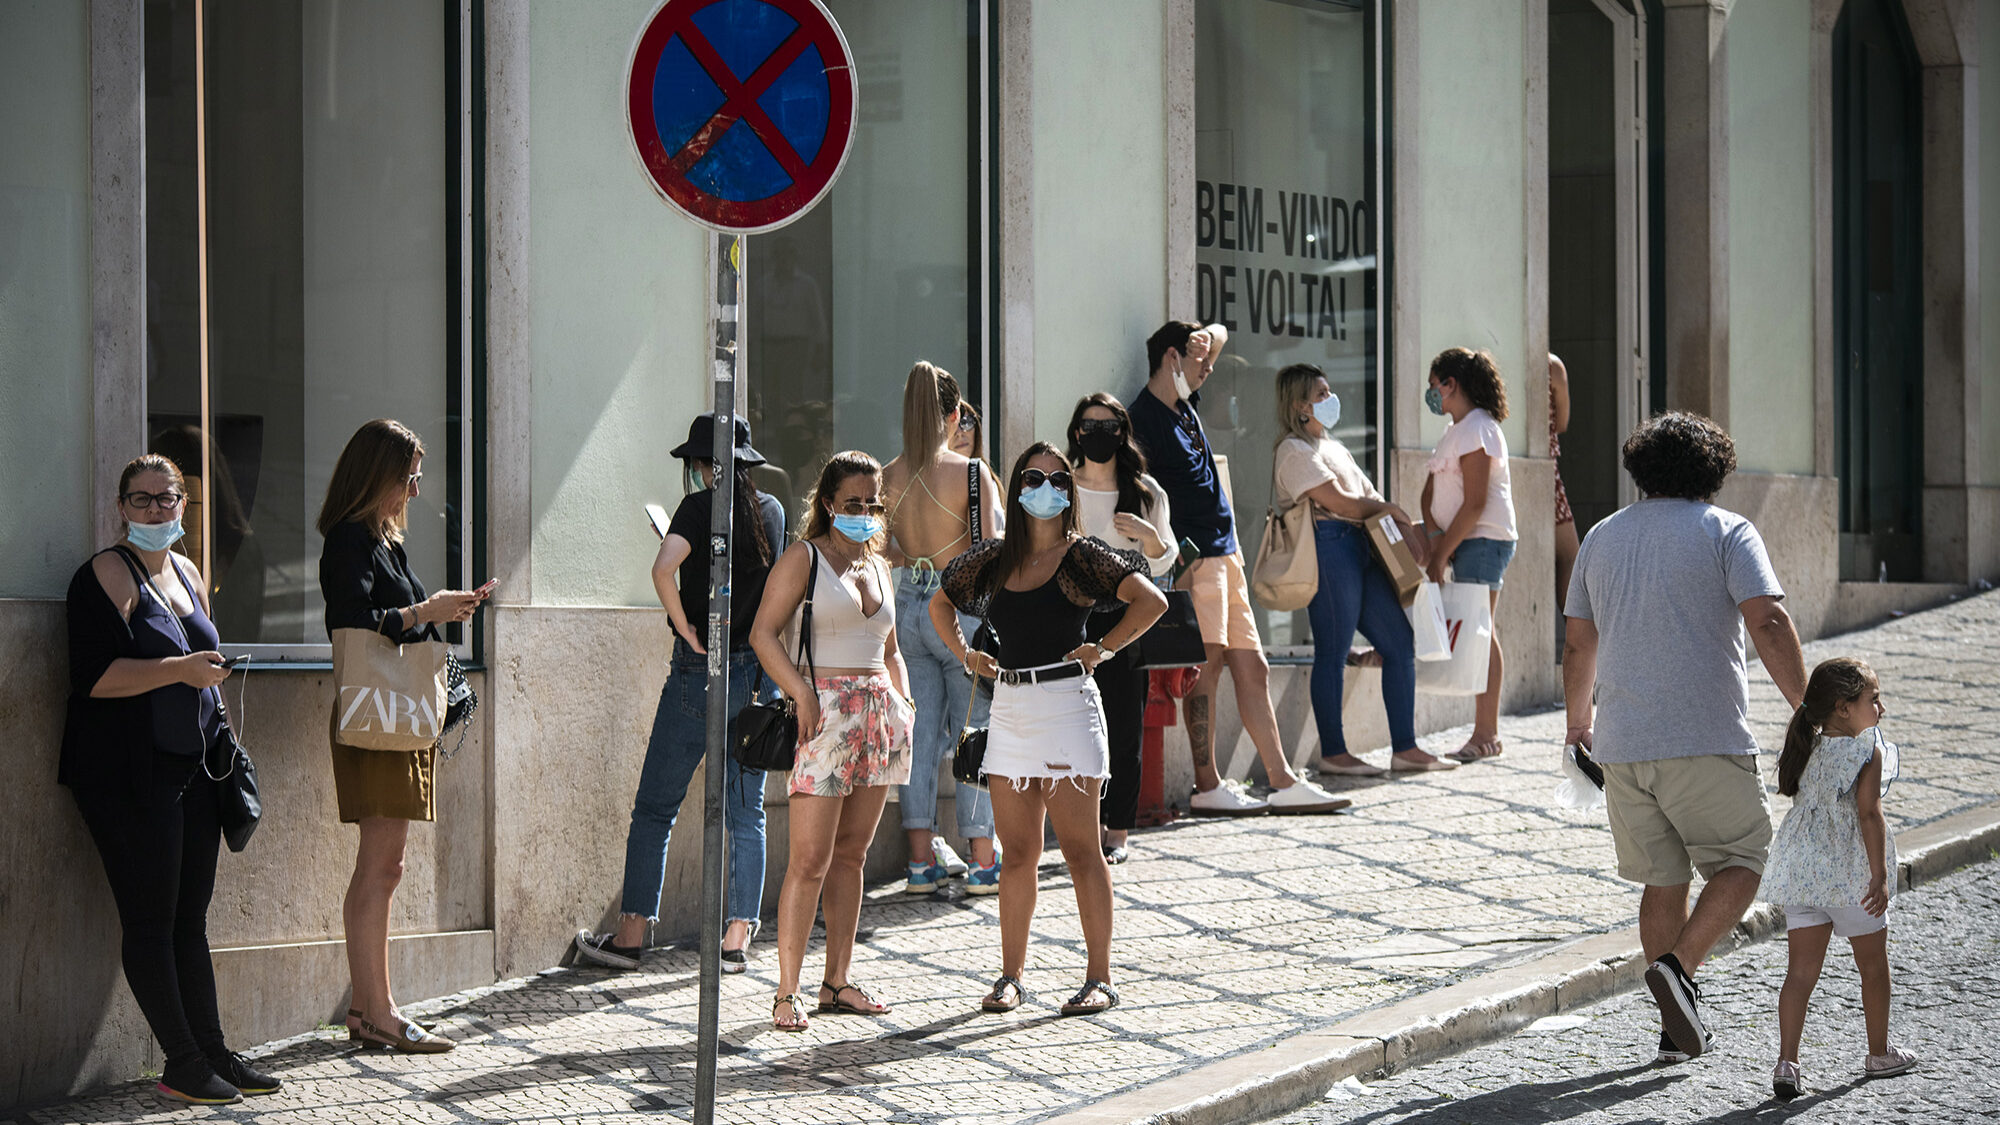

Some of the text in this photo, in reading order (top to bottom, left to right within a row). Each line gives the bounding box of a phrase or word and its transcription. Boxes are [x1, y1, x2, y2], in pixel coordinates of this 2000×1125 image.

[1196, 180, 1372, 264] BEM-VINDO
[1197, 263, 1347, 341] DE VOLTA!
[969, 463, 980, 543] TWINSET TWINSET
[339, 685, 439, 738] ZARA
